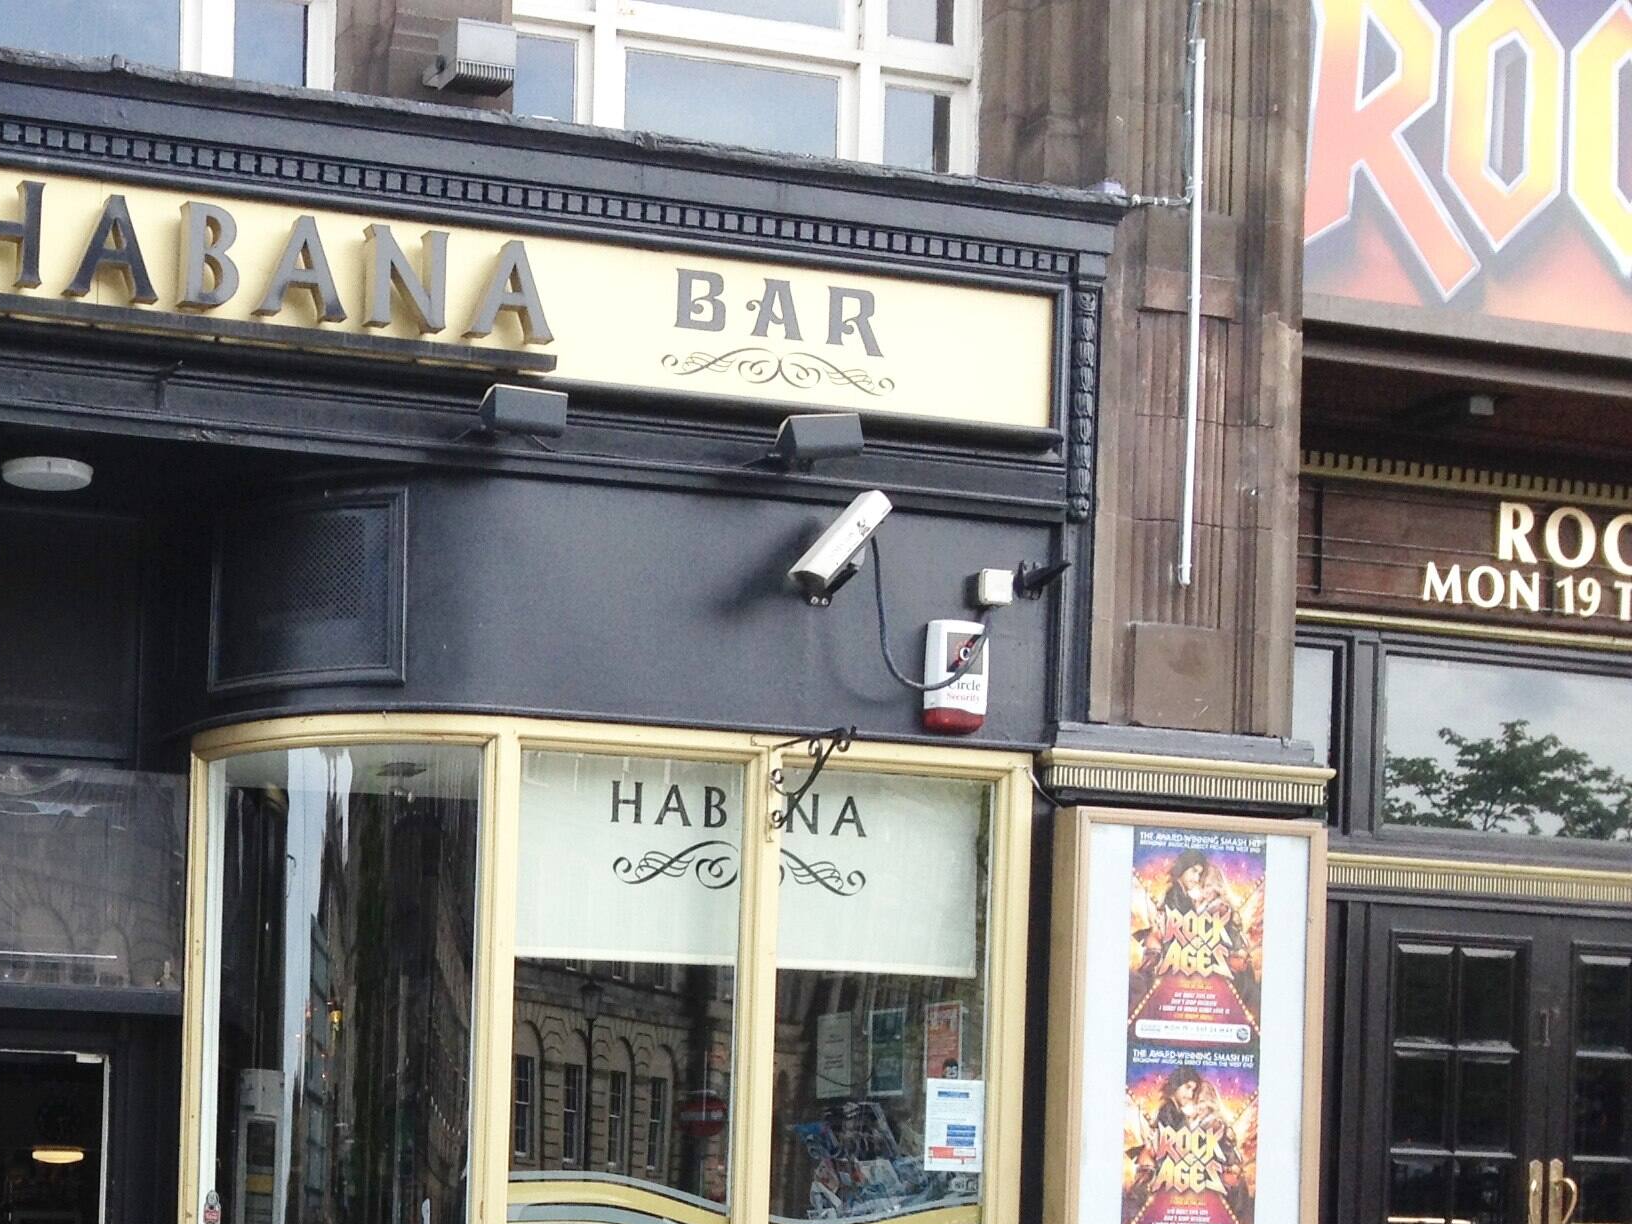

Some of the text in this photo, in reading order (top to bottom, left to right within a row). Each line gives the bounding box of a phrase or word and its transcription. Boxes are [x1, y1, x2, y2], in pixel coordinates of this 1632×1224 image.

[673, 267, 884, 358] BAR
[1422, 561, 1541, 612] MON
[1556, 575, 1603, 617] 19
[610, 780, 867, 838] HABNA
[1163, 904, 1233, 950] ROCK
[1158, 939, 1235, 980] AGES
[1156, 1122, 1227, 1162] ROCK
[1151, 1156, 1228, 1195] AGES
